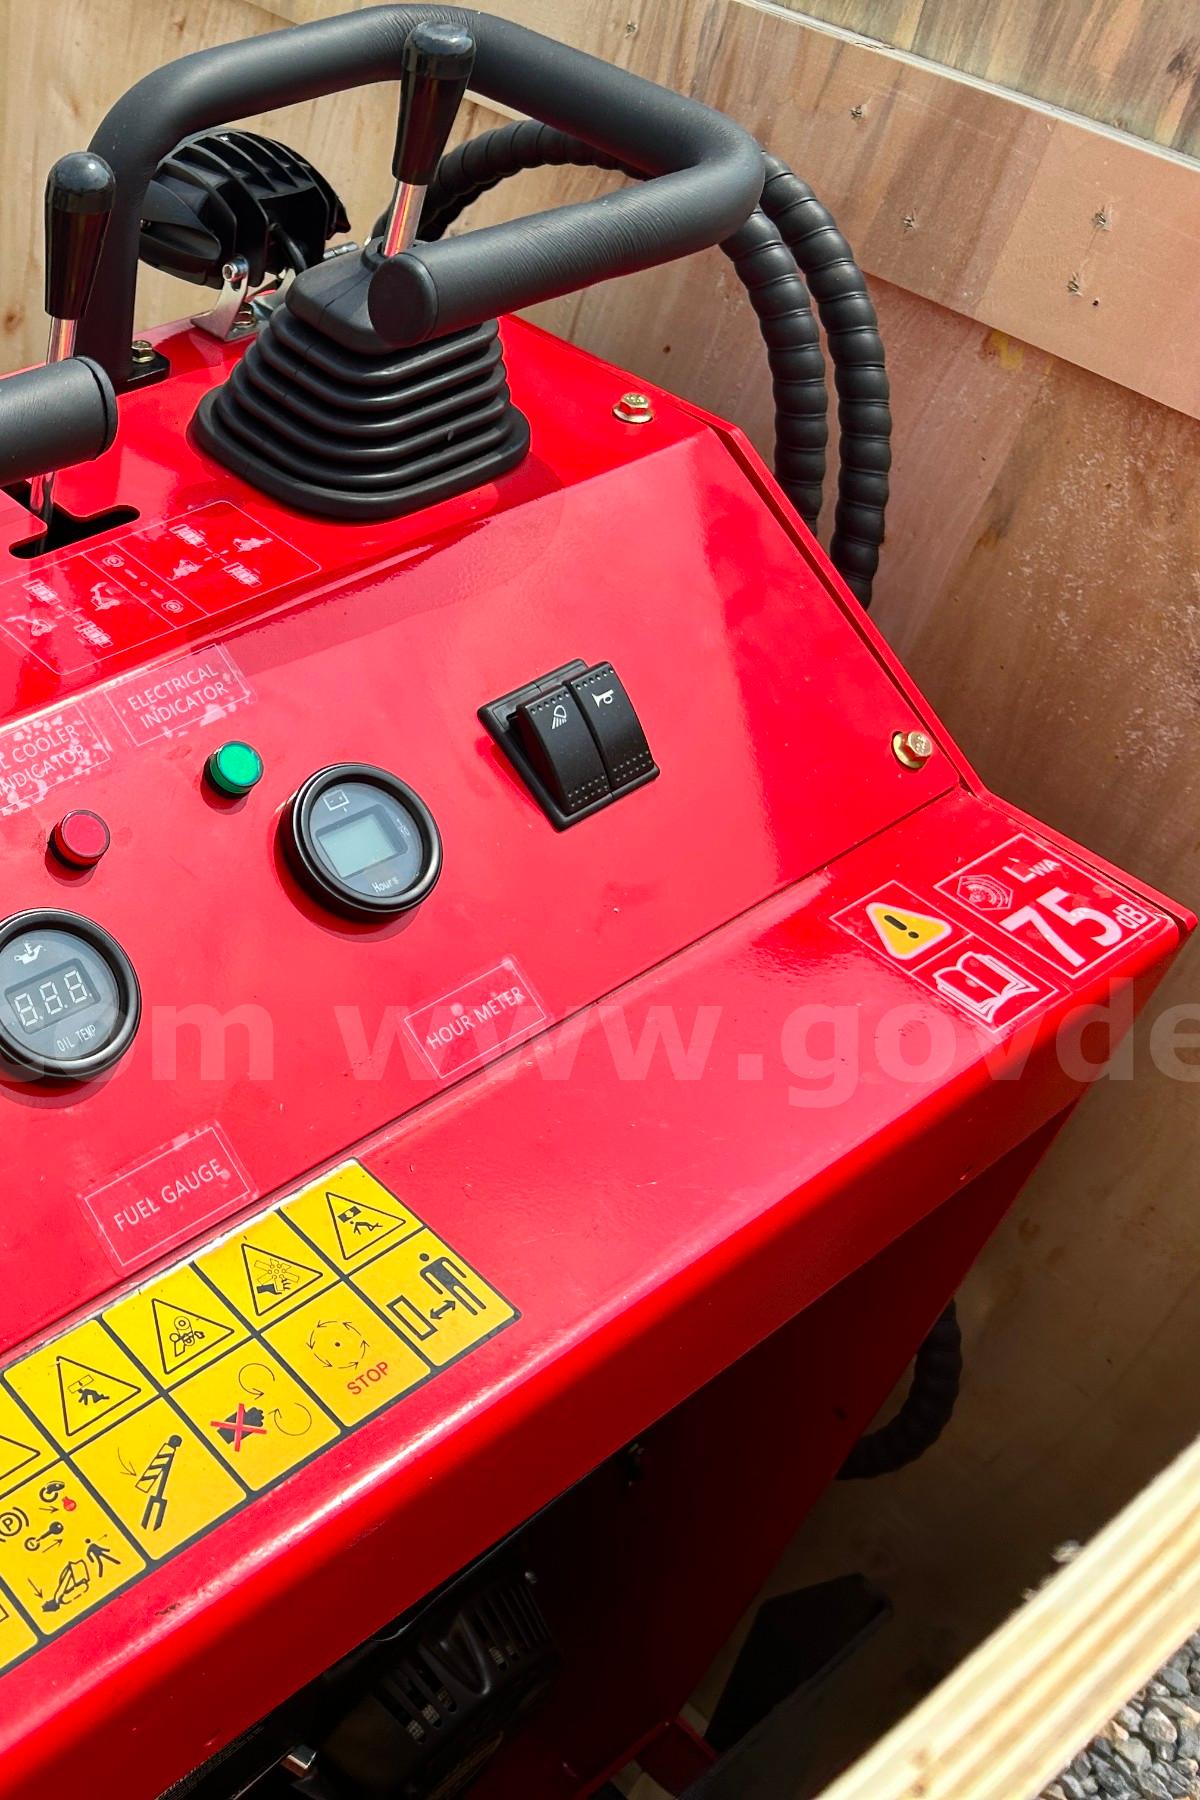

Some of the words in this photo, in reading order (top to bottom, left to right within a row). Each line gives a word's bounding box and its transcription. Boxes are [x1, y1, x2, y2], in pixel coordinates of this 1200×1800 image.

[127, 663, 219, 712] ELECTRICAL
[139, 680, 229, 730] INDICATOR
[11, 725, 81, 768] COOLER
[371, 876, 399, 893] Hours
[998, 886, 1123, 968] 75
[56, 1037, 75, 1052] OIL
[75, 1024, 96, 1042] TEMP
[426, 1015, 476, 1050] HOUR
[473, 986, 526, 1024] METER
[112, 1196, 161, 1232] FUEL
[160, 1158, 225, 1204] GAUGE
[346, 1361, 388, 1395] STOP
